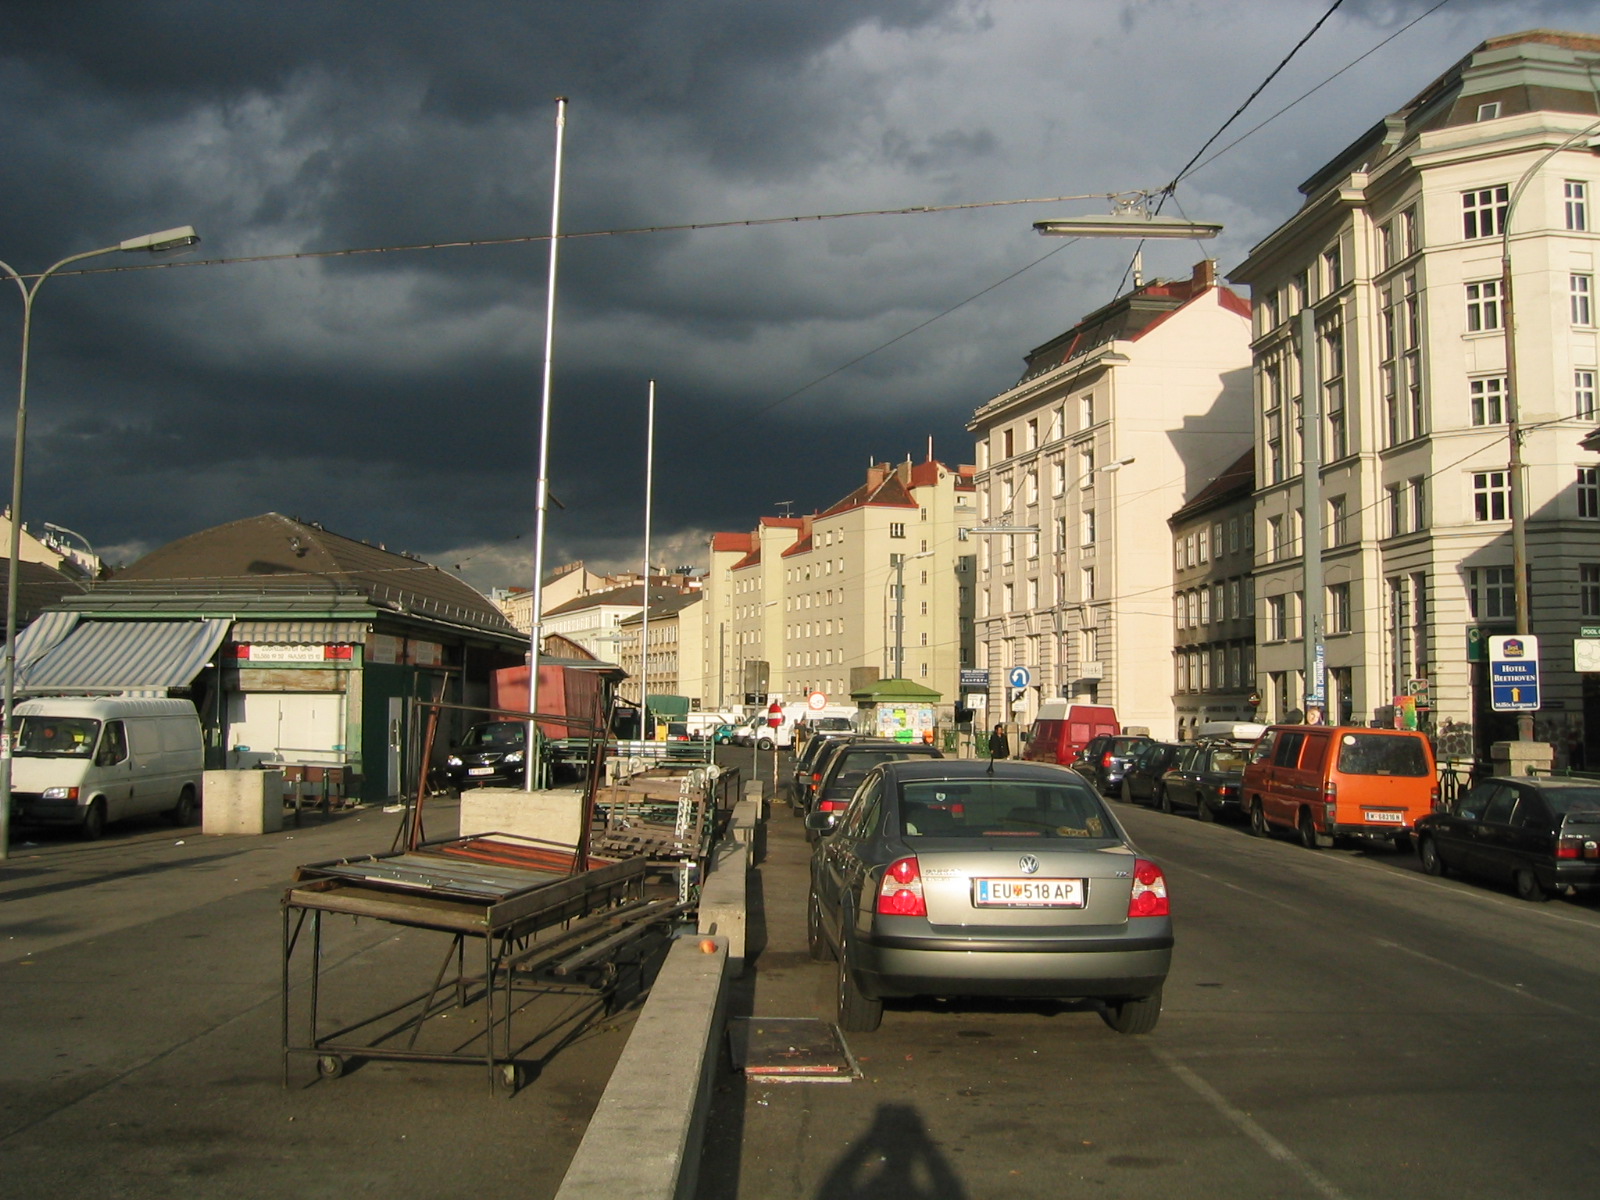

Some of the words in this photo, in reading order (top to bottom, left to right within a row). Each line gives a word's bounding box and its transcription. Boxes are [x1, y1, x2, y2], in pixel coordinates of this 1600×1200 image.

[1494, 674, 1535, 682] BEETHOVEN
[992, 883, 1012, 899] EU
[1023, 883, 1051, 899] 518
[1054, 883, 1075, 900] AP
